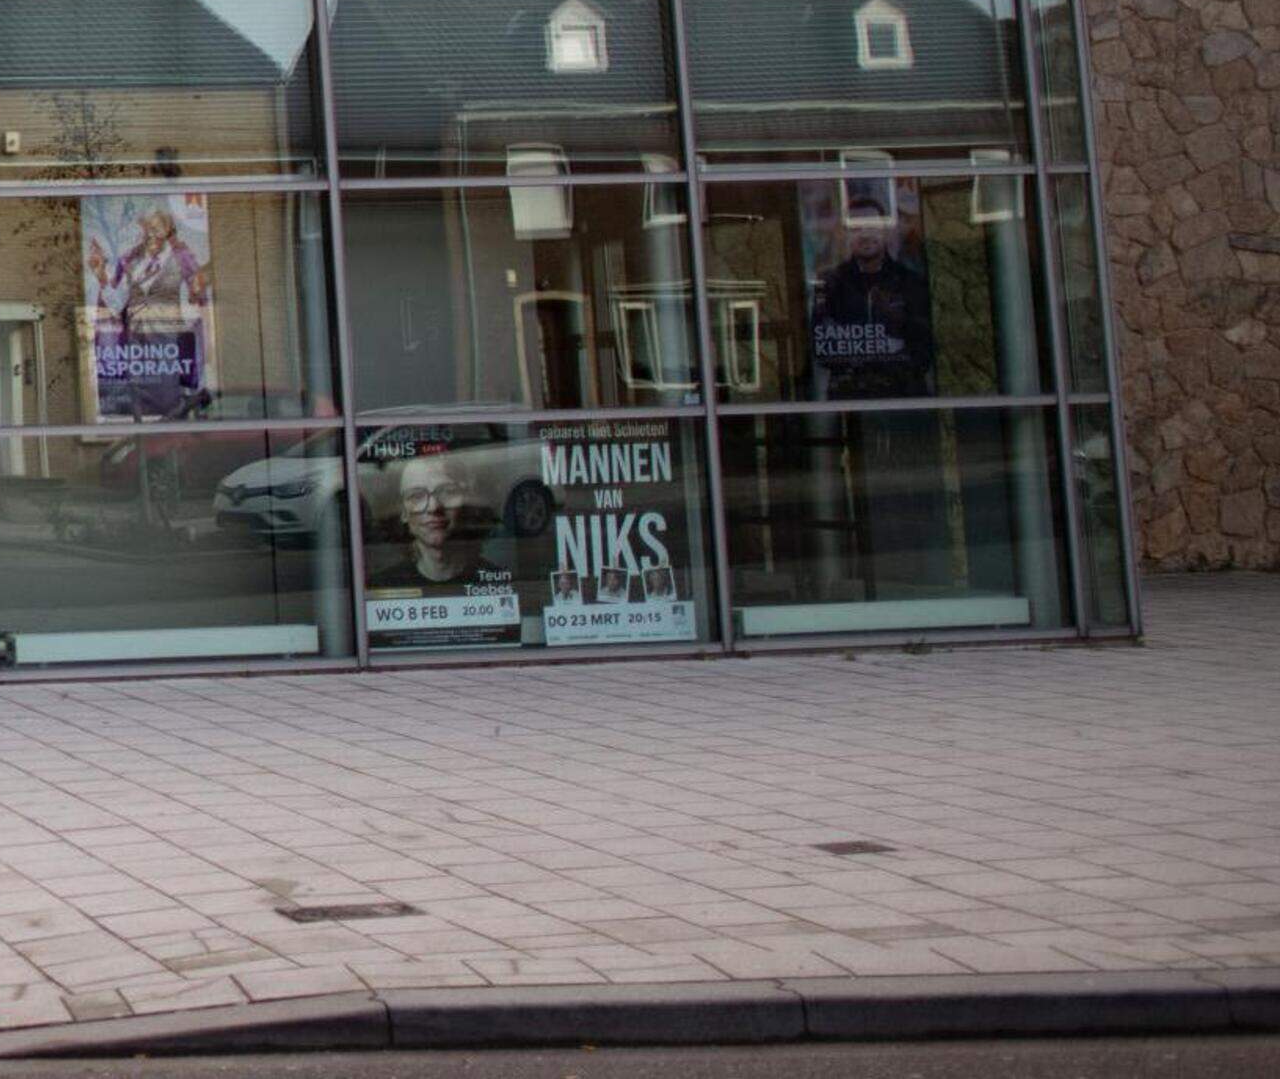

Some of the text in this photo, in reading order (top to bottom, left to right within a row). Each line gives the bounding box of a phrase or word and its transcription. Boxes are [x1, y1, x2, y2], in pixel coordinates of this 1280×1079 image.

[814, 323, 886, 340] SANDER
[96, 359, 192, 377] ASPORAAT
[362, 438, 417, 458] THUIS
[541, 441, 672, 486] MANNEN
[593, 487, 624, 509] VAN
[555, 511, 669, 579] NIKS
[478, 569, 513, 582] Teun
[464, 583, 513, 597] Toebes
[376, 606, 405, 621] WO
[408, 606, 418, 620] 8
[421, 605, 449, 620] FEB
[548, 615, 568, 627] DO
[570, 614, 588, 627] 23
[591, 612, 621, 625] MRT
